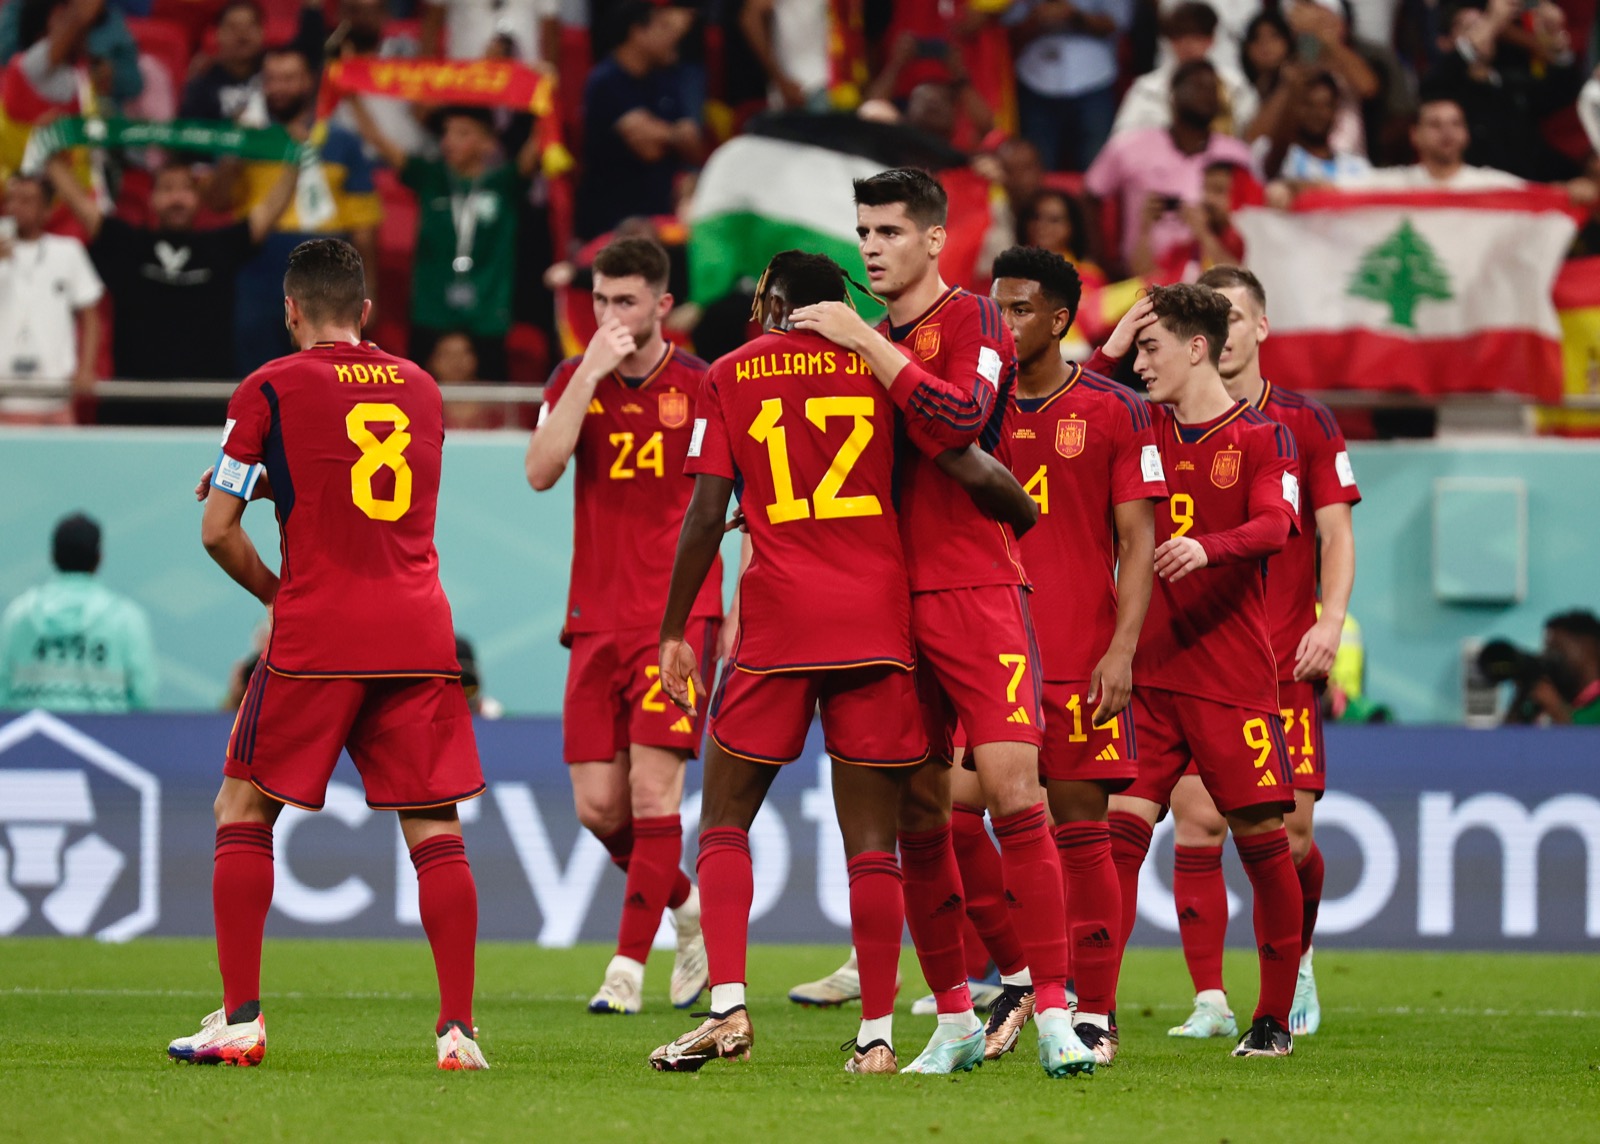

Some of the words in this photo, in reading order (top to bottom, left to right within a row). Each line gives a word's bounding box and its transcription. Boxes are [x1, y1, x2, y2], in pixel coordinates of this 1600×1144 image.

[333, 363, 405, 384] KOKE
[735, 351, 837, 383] WILLIAMS
[345, 402, 413, 522] 8
[609, 432, 665, 479] 24
[748, 396, 883, 525] 12
[1022, 464, 1049, 514] 4
[1170, 493, 1194, 540] 9
[998, 653, 1026, 703] 7
[1242, 717, 1272, 769] 9
